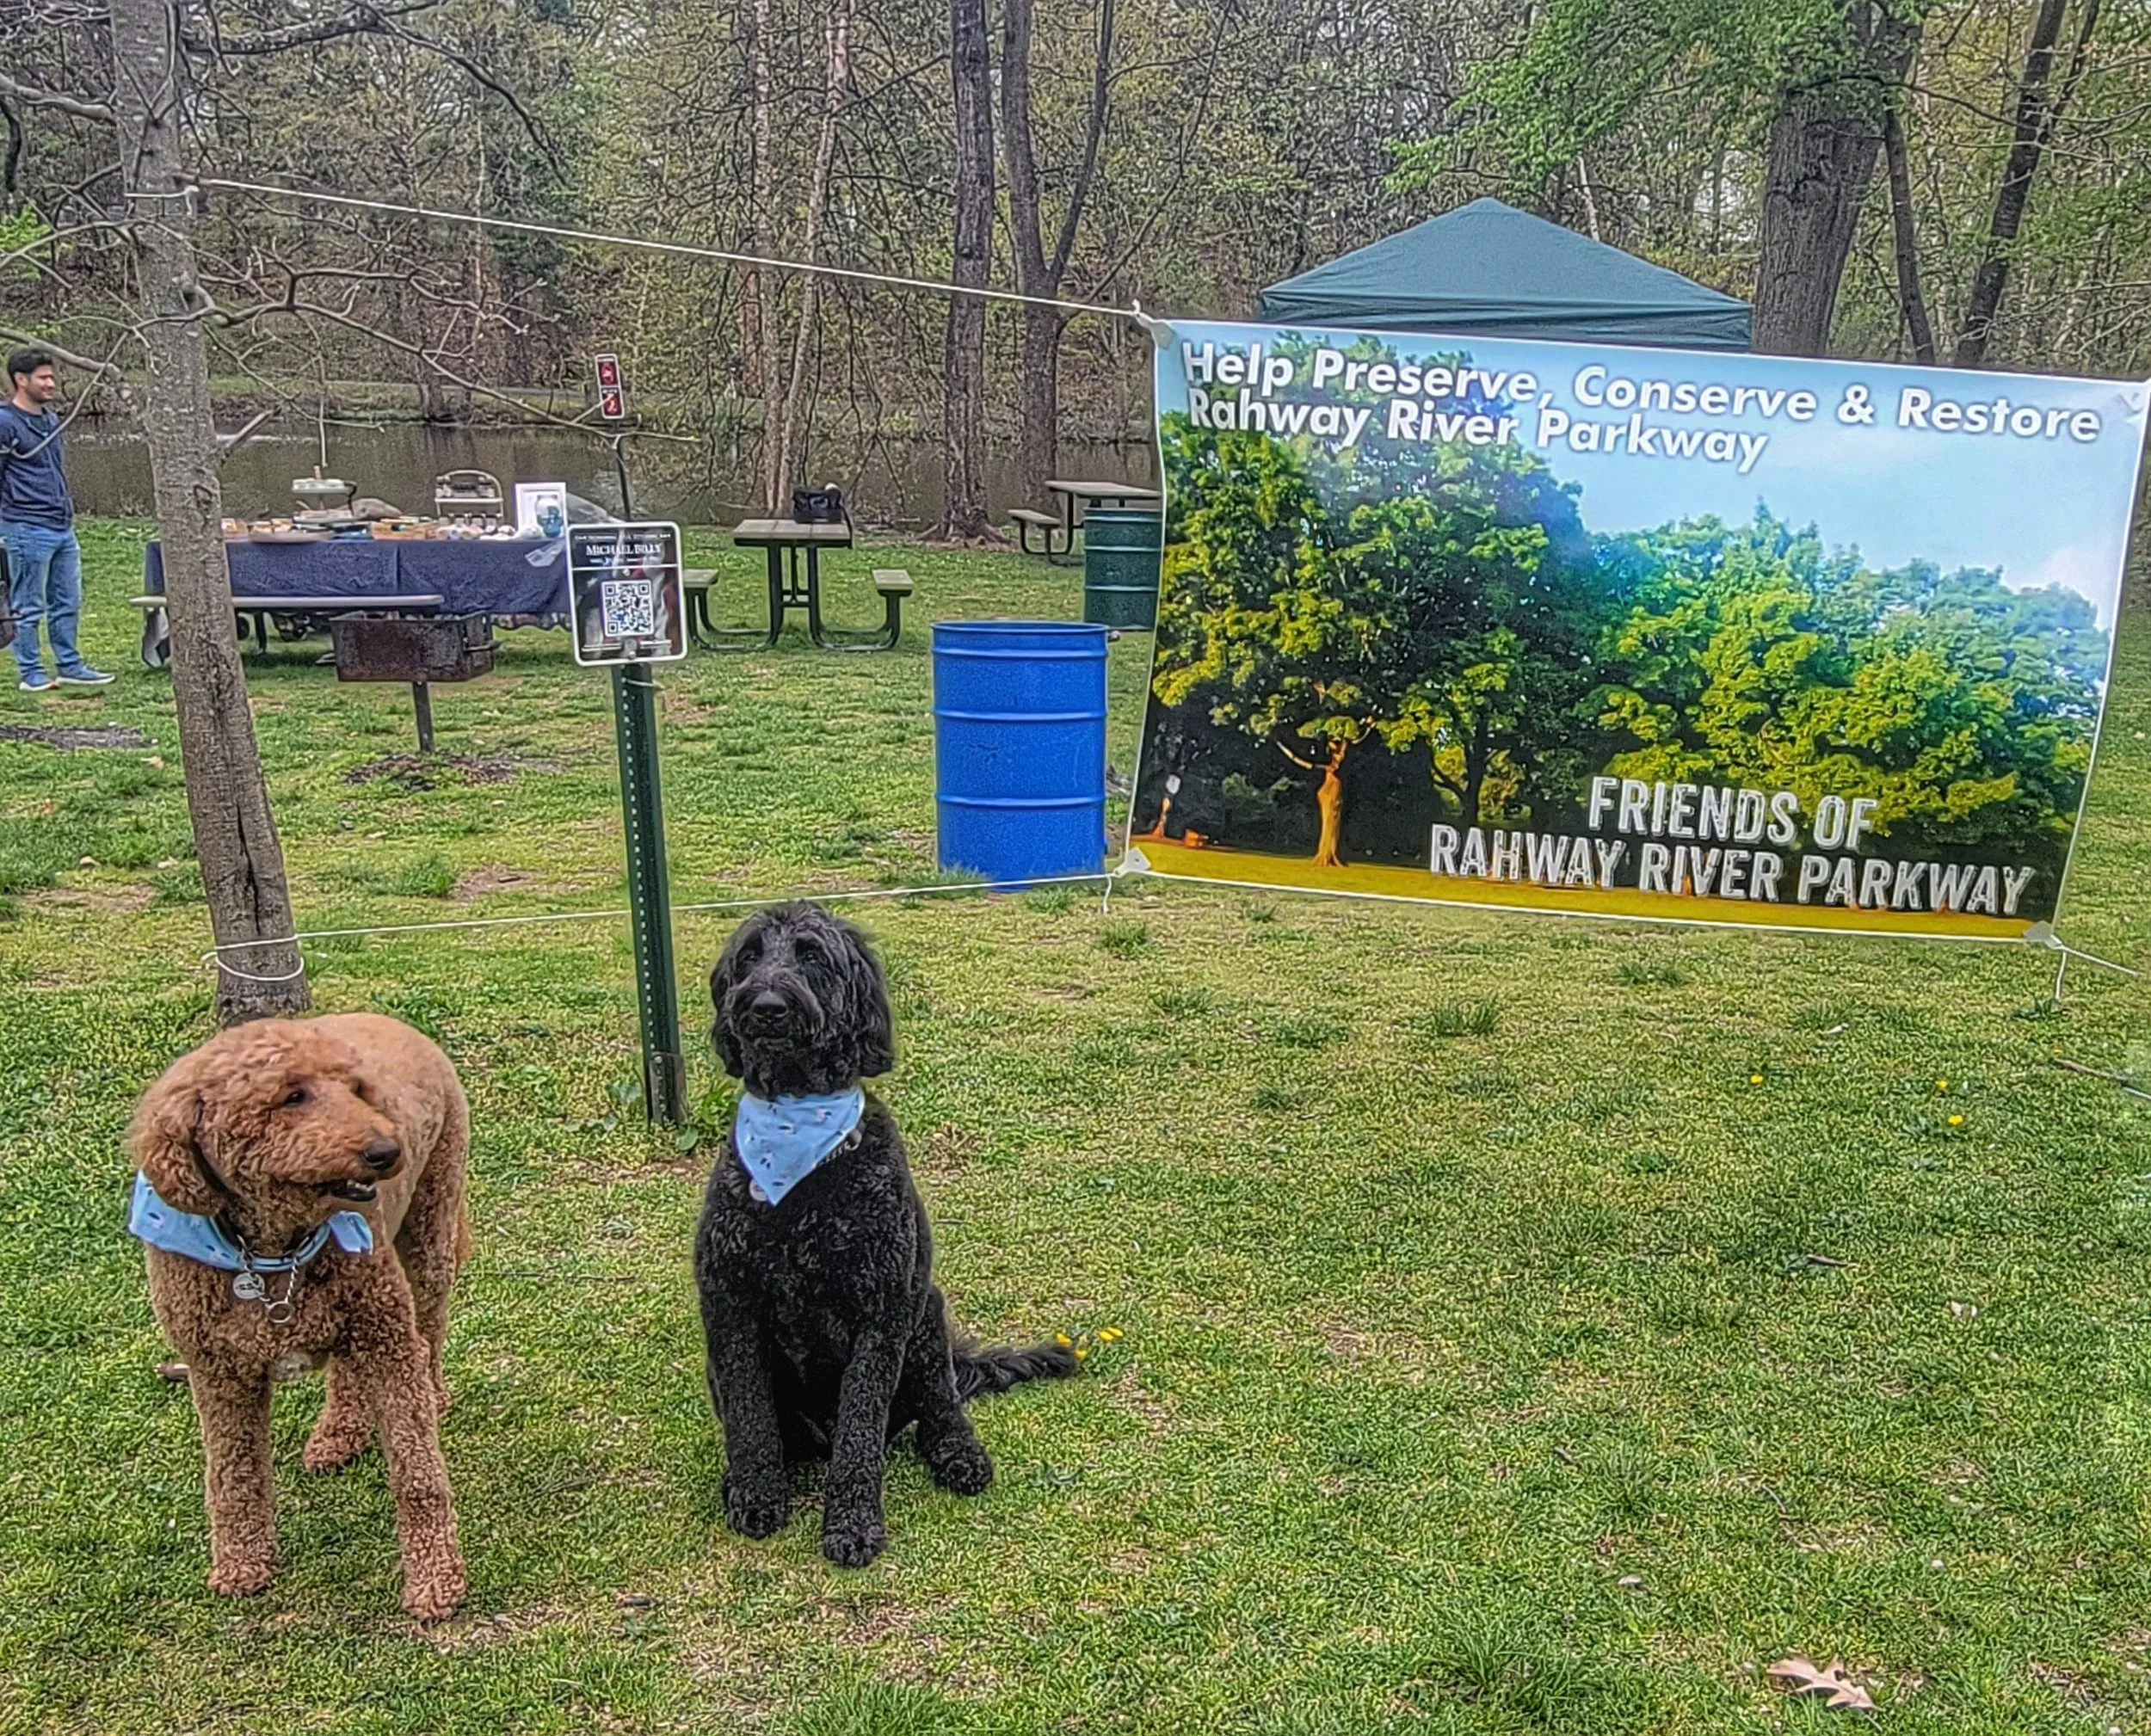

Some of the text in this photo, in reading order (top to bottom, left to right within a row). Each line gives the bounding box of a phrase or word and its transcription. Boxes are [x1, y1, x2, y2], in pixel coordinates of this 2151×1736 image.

[1181, 341, 2100, 442] Help Preserve, Conserve & Restore
[1187, 387, 1768, 474] Rahway River Parkway
[1587, 775, 1879, 853] FRIENDS OF
[1429, 822, 2036, 916] RAHWAY RIVER PARKWAY
